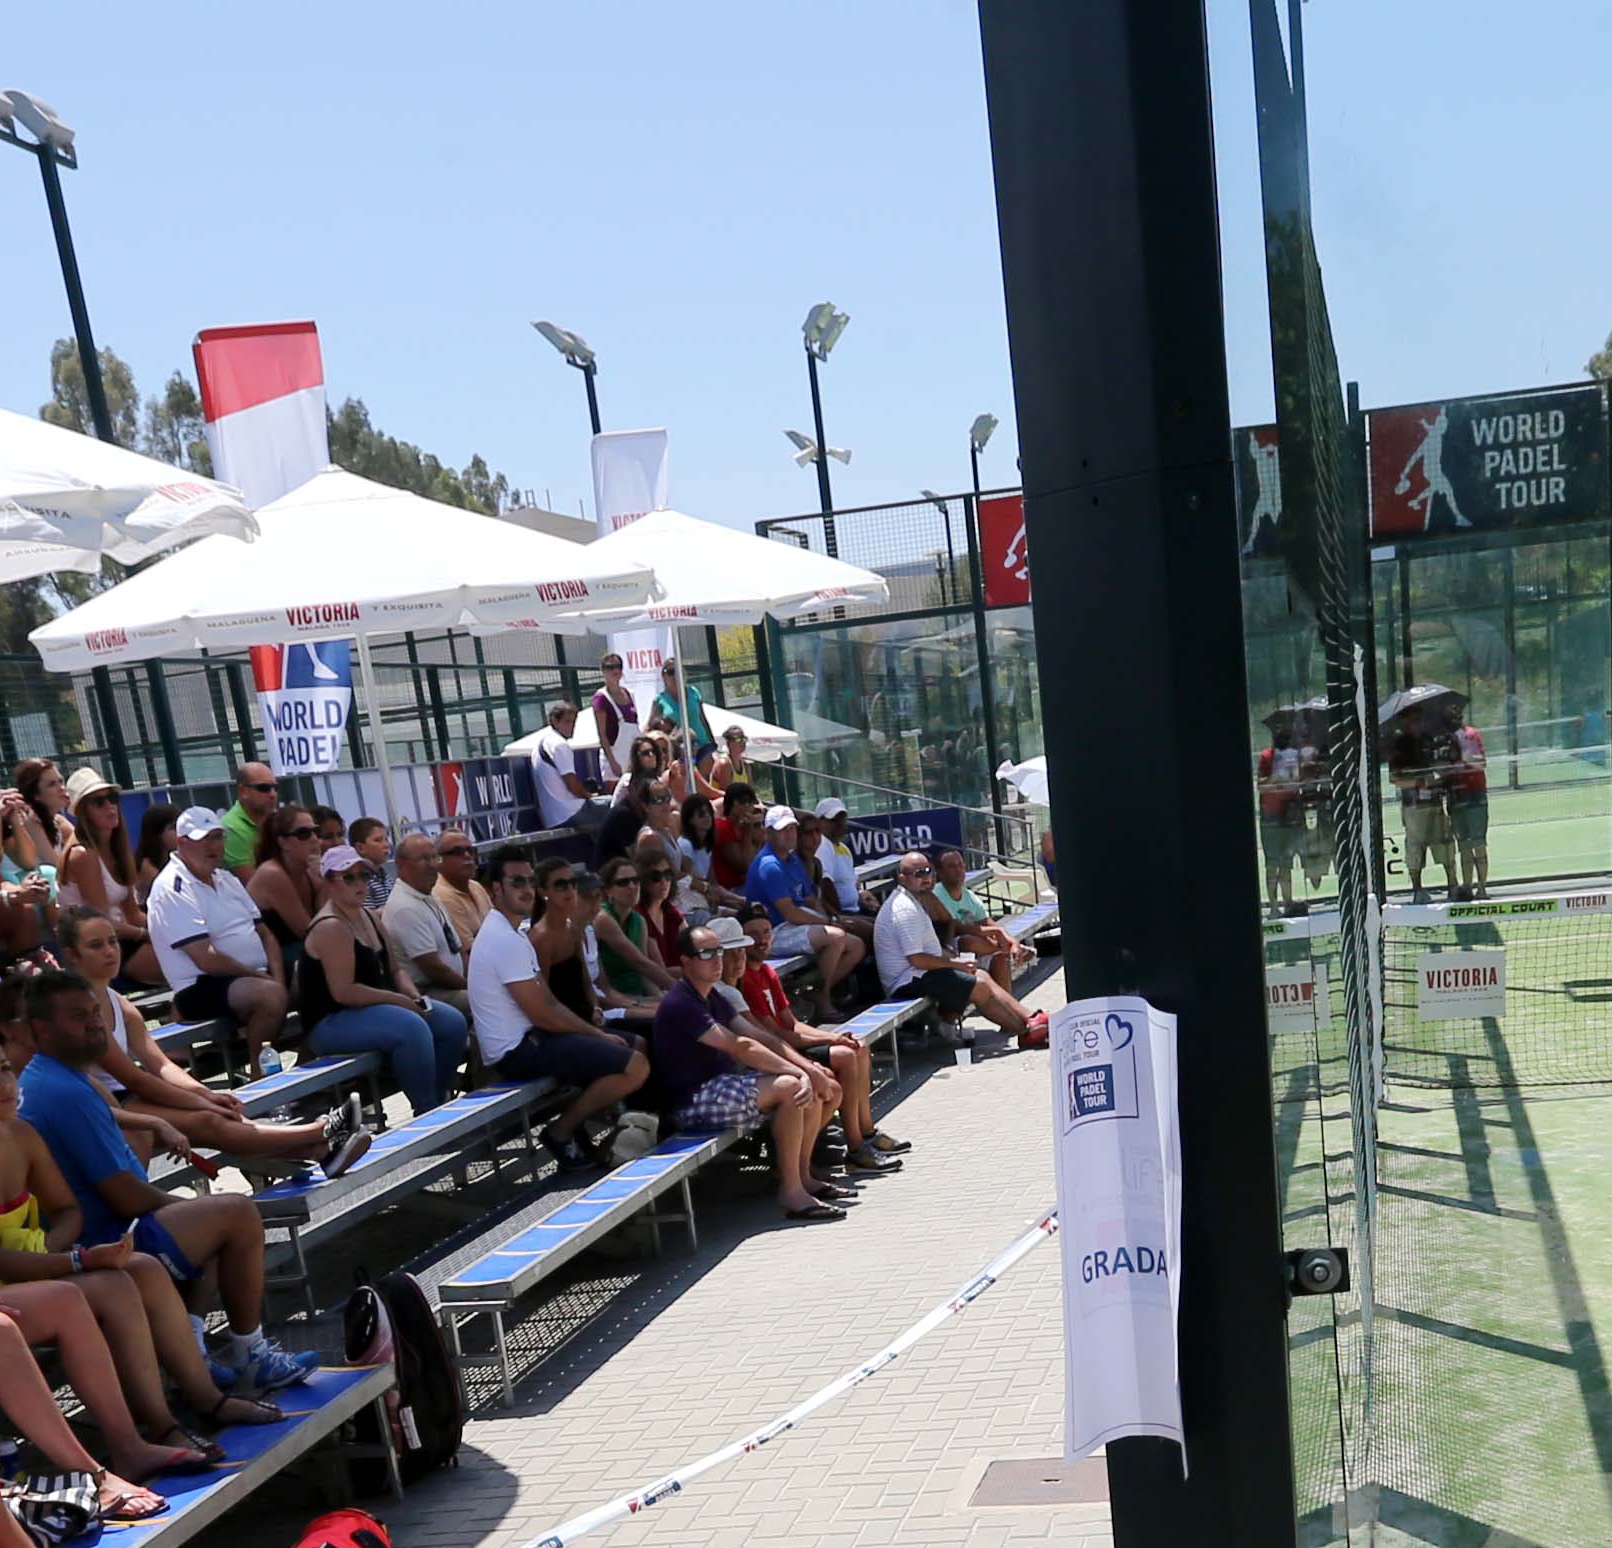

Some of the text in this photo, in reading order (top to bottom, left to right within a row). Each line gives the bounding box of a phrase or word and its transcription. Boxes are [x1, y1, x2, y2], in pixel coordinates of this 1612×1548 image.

[1470, 409, 1566, 447] WORLD
[1483, 442, 1568, 479] PADEL
[1494, 476, 1566, 510] TOUR
[535, 578, 590, 603] VICTORIA
[285, 600, 362, 627] VICTORIA
[84, 625, 130, 652] VICTORIA
[265, 699, 344, 732] WORLD
[475, 773, 514, 807] WRLD
[849, 824, 934, 856] WORLD
[1448, 900, 1557, 919] OFFICIAL COURT
[1565, 895, 1608, 910] VICTORIA
[1425, 965, 1499, 991] VICTORIA
[1075, 1069, 1107, 1087] WORLD
[1079, 1082, 1107, 1098] PADEL
[1082, 1094, 1108, 1110] TOUR
[1081, 1245, 1169, 1285] GRADA
